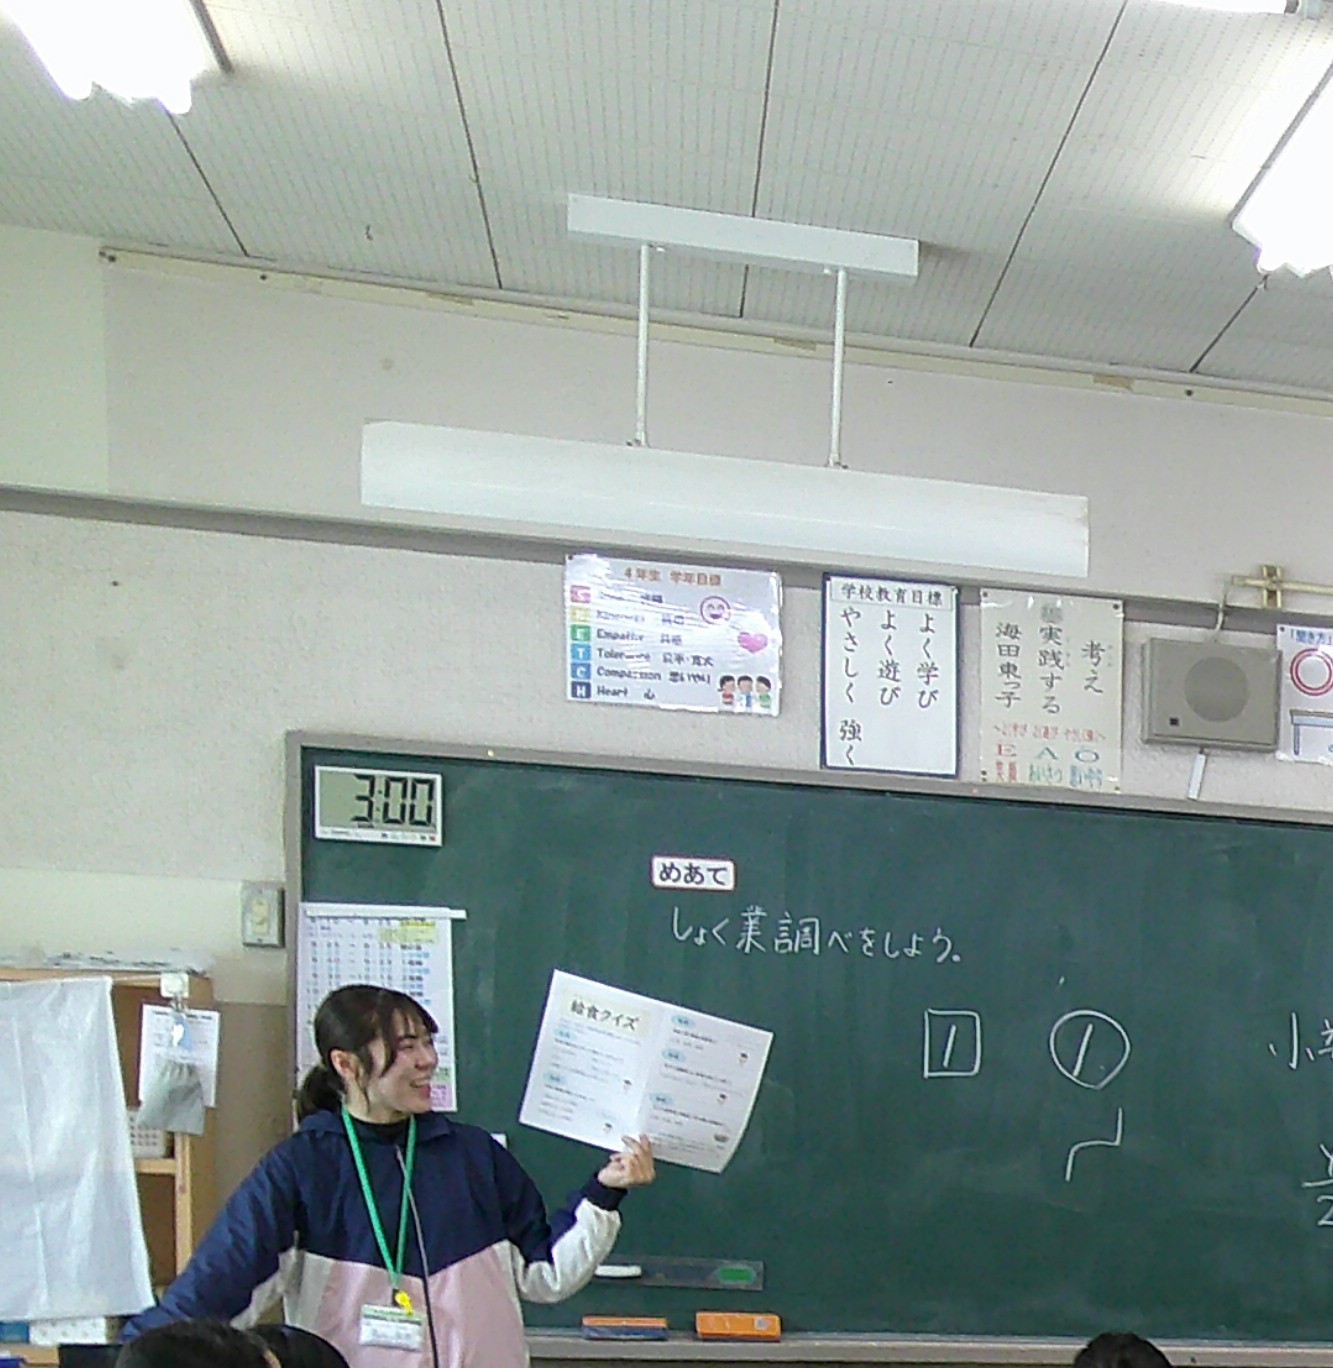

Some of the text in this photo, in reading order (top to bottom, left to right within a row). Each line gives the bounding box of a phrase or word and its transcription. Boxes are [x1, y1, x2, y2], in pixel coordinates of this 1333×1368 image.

[841, 583, 943, 606] 学校教育目標
[878, 610, 901, 705] よく遊び
[916, 613, 939, 708] よく学び
[1039, 626, 1065, 714] 実践する
[1081, 640, 1106, 694] 考え
[839, 606, 862, 765] やさしく 強く
[352, 773, 434, 826] 3:00
[659, 862, 728, 886] めあて
[571, 999, 640, 1031] 給食クイズ
